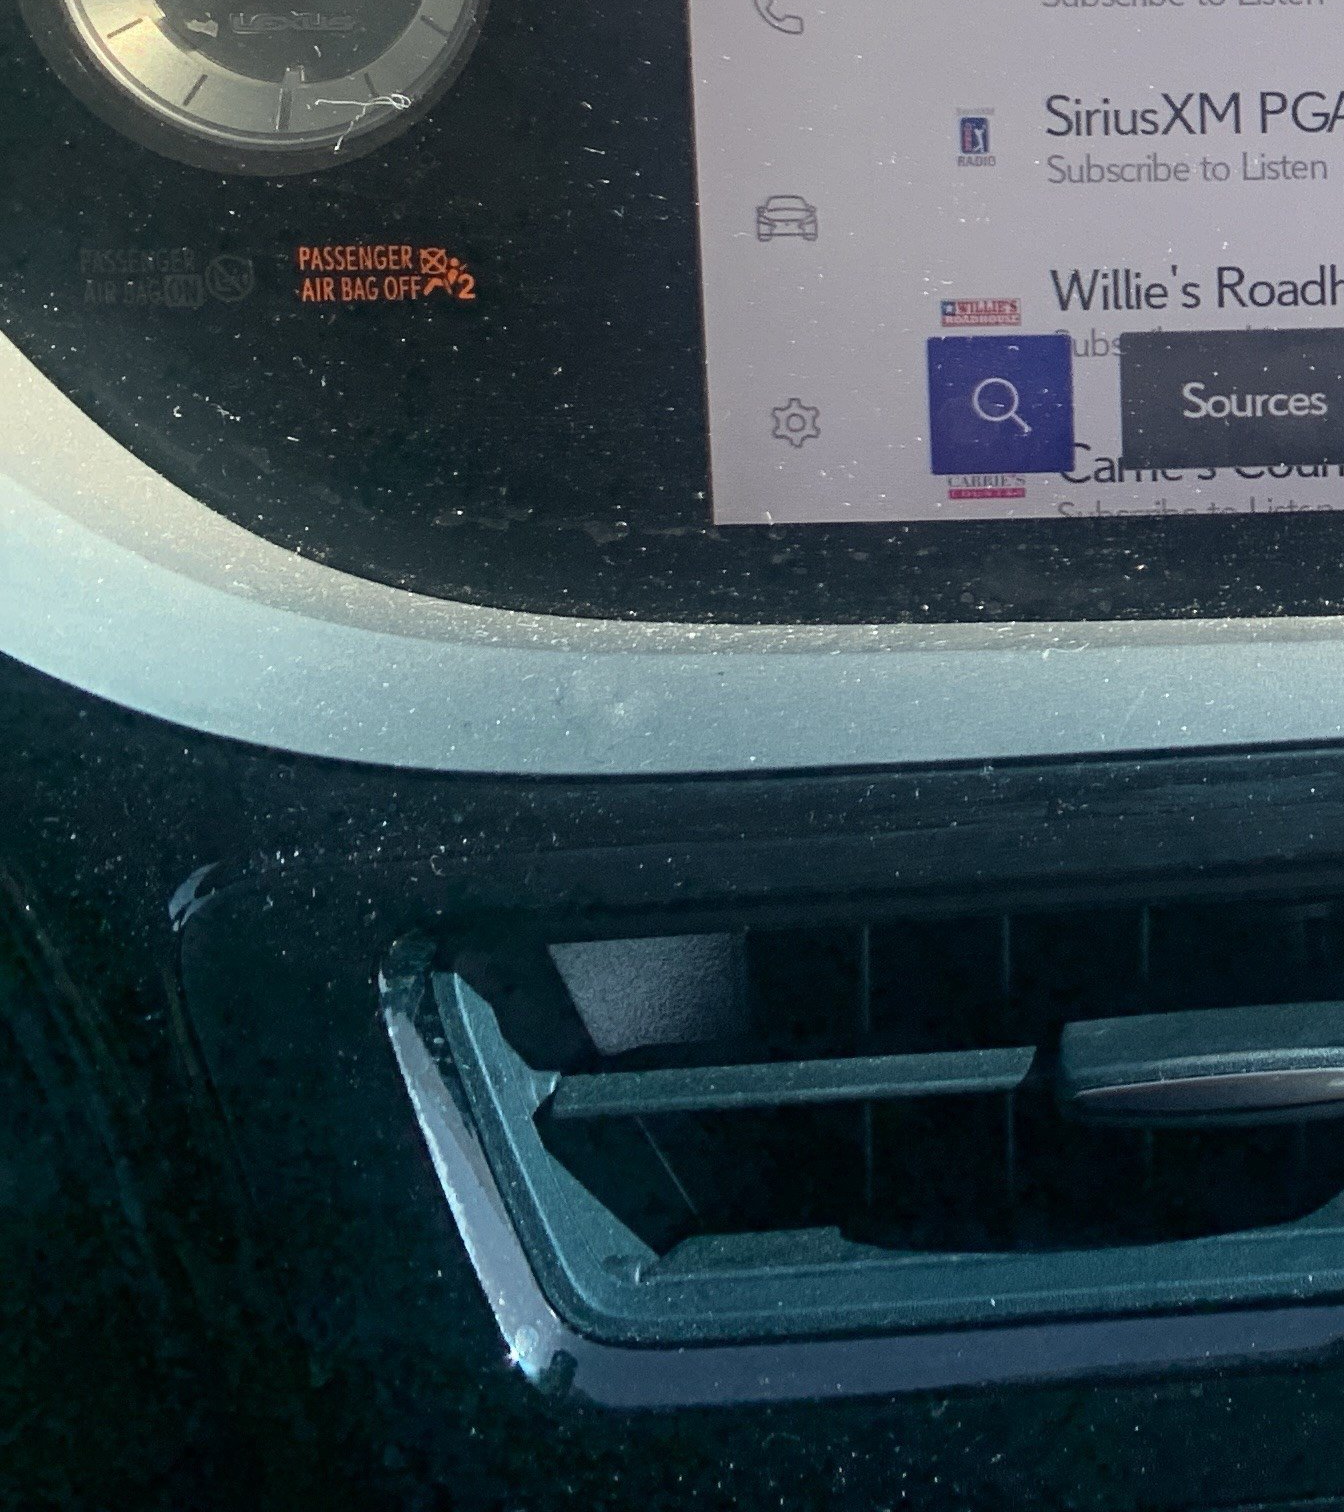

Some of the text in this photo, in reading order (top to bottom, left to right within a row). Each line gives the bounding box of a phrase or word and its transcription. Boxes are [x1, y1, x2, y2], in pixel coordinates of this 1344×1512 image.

[1045, 91, 1242, 138] SiriusXM
[1046, 151, 1329, 185] Subscribe to Listen
[298, 244, 413, 271] PASSENGER
[302, 275, 421, 303] AIR BAG OFF
[1049, 264, 1202, 312] Willie's
[1181, 381, 1329, 419] Sources
